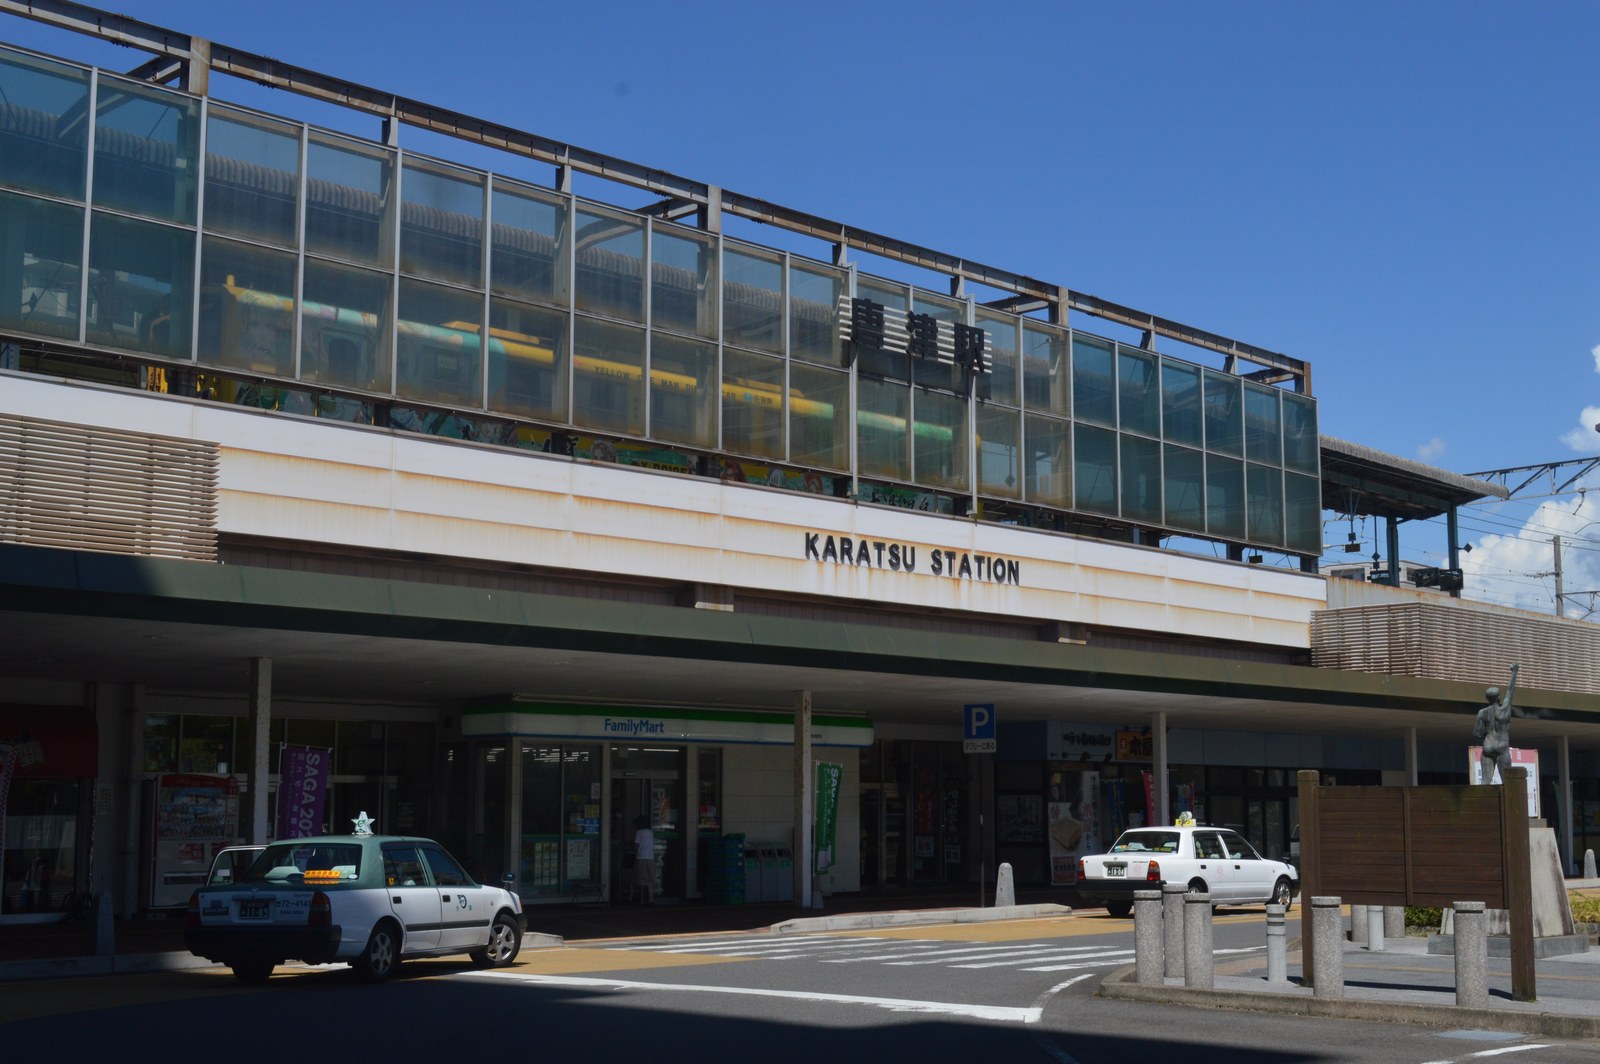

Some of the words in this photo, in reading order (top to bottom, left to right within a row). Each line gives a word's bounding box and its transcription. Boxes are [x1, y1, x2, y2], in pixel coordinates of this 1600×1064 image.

[851, 298, 985, 373] 唐津駅
[661, 379, 679, 390] MAN
[805, 532, 915, 573] KARATSU
[931, 549, 1019, 585] STATION
[604, 718, 664, 736] FamilyMart
[971, 707, 989, 736] P
[301, 752, 321, 804] SAGA
[298, 807, 315, 838] 202
